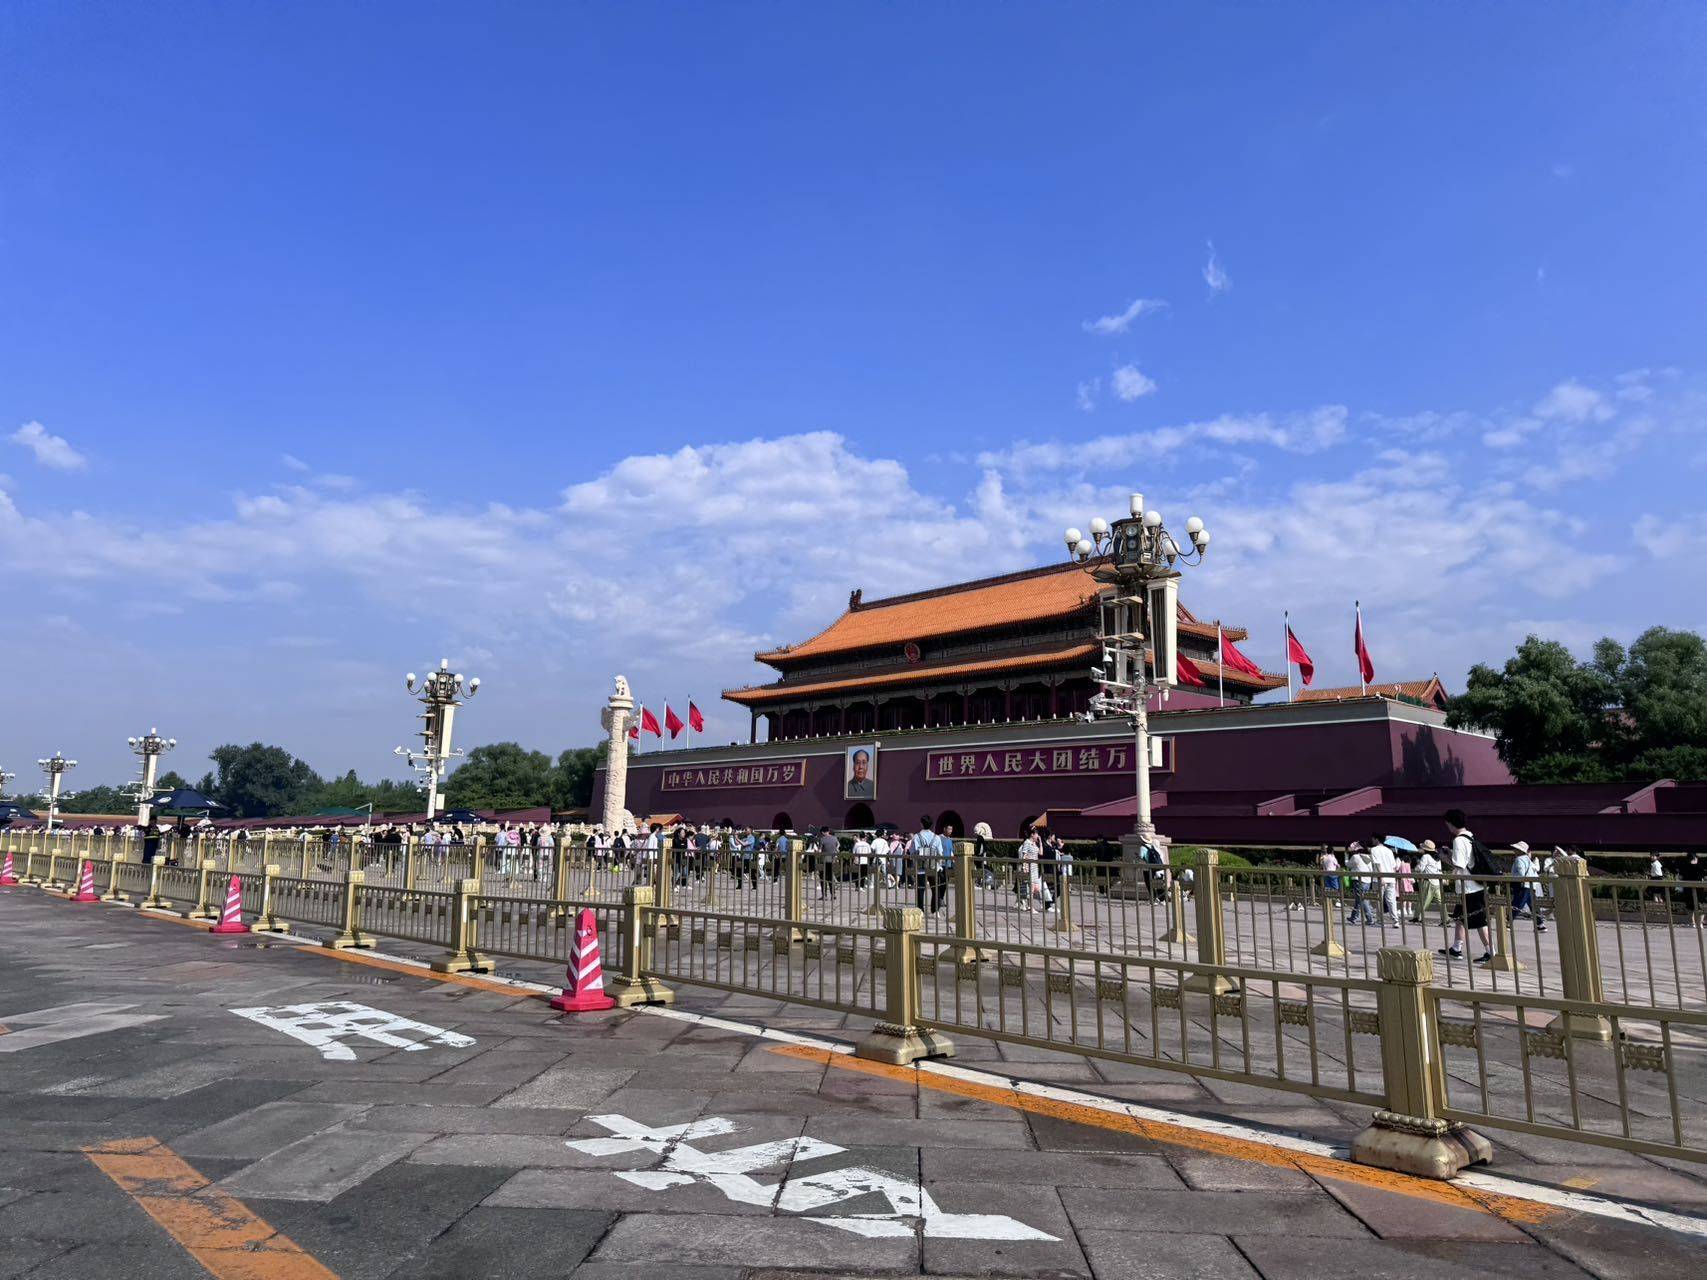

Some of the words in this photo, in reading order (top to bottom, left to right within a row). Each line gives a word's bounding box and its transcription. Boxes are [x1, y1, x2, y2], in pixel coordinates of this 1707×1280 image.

[938, 747, 1146, 775] 世界人民大团结万
[668, 766, 795, 786] 中华人民共和国万岁
